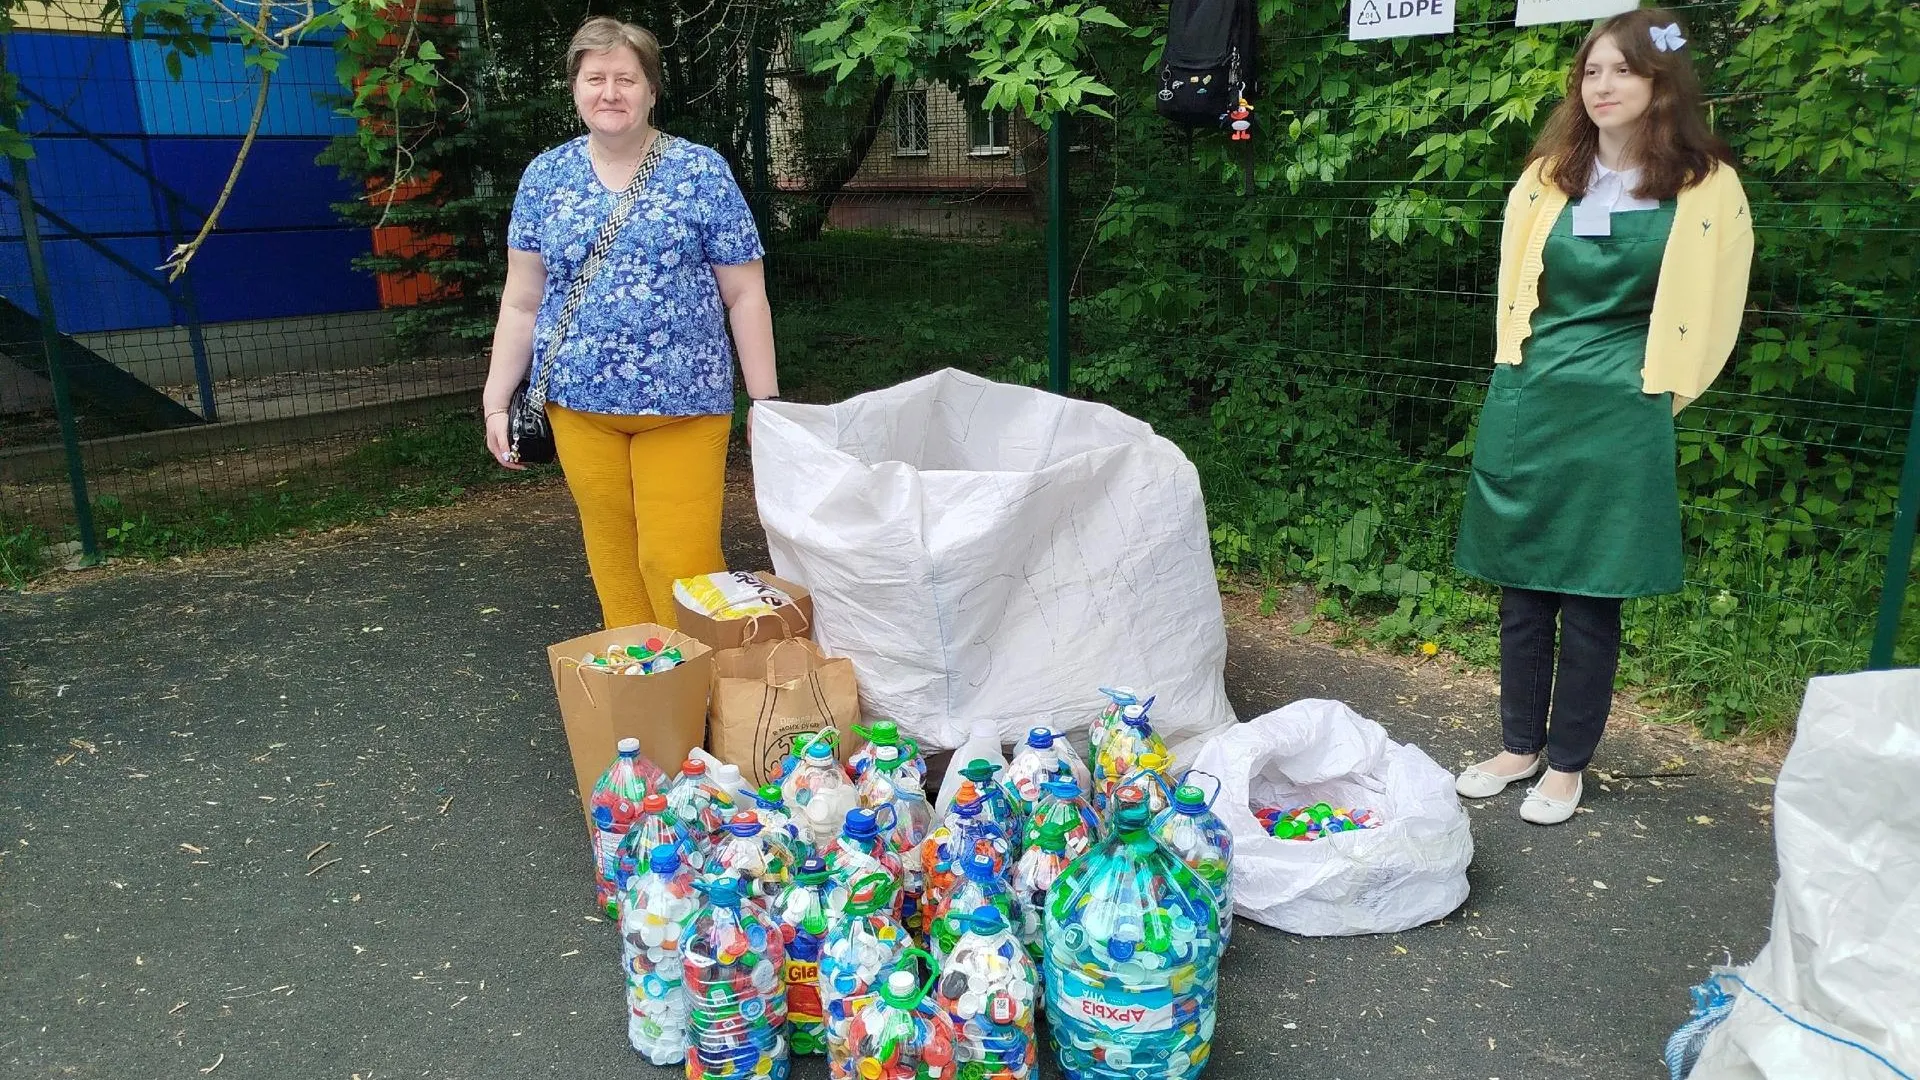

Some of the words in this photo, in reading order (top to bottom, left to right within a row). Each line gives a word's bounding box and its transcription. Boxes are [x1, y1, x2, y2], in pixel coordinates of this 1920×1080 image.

[1386, 0, 1443, 20] LDPE
[1082, 988, 1105, 1003] VITA
[1082, 1000, 1146, 1023] АРХЫЗ
